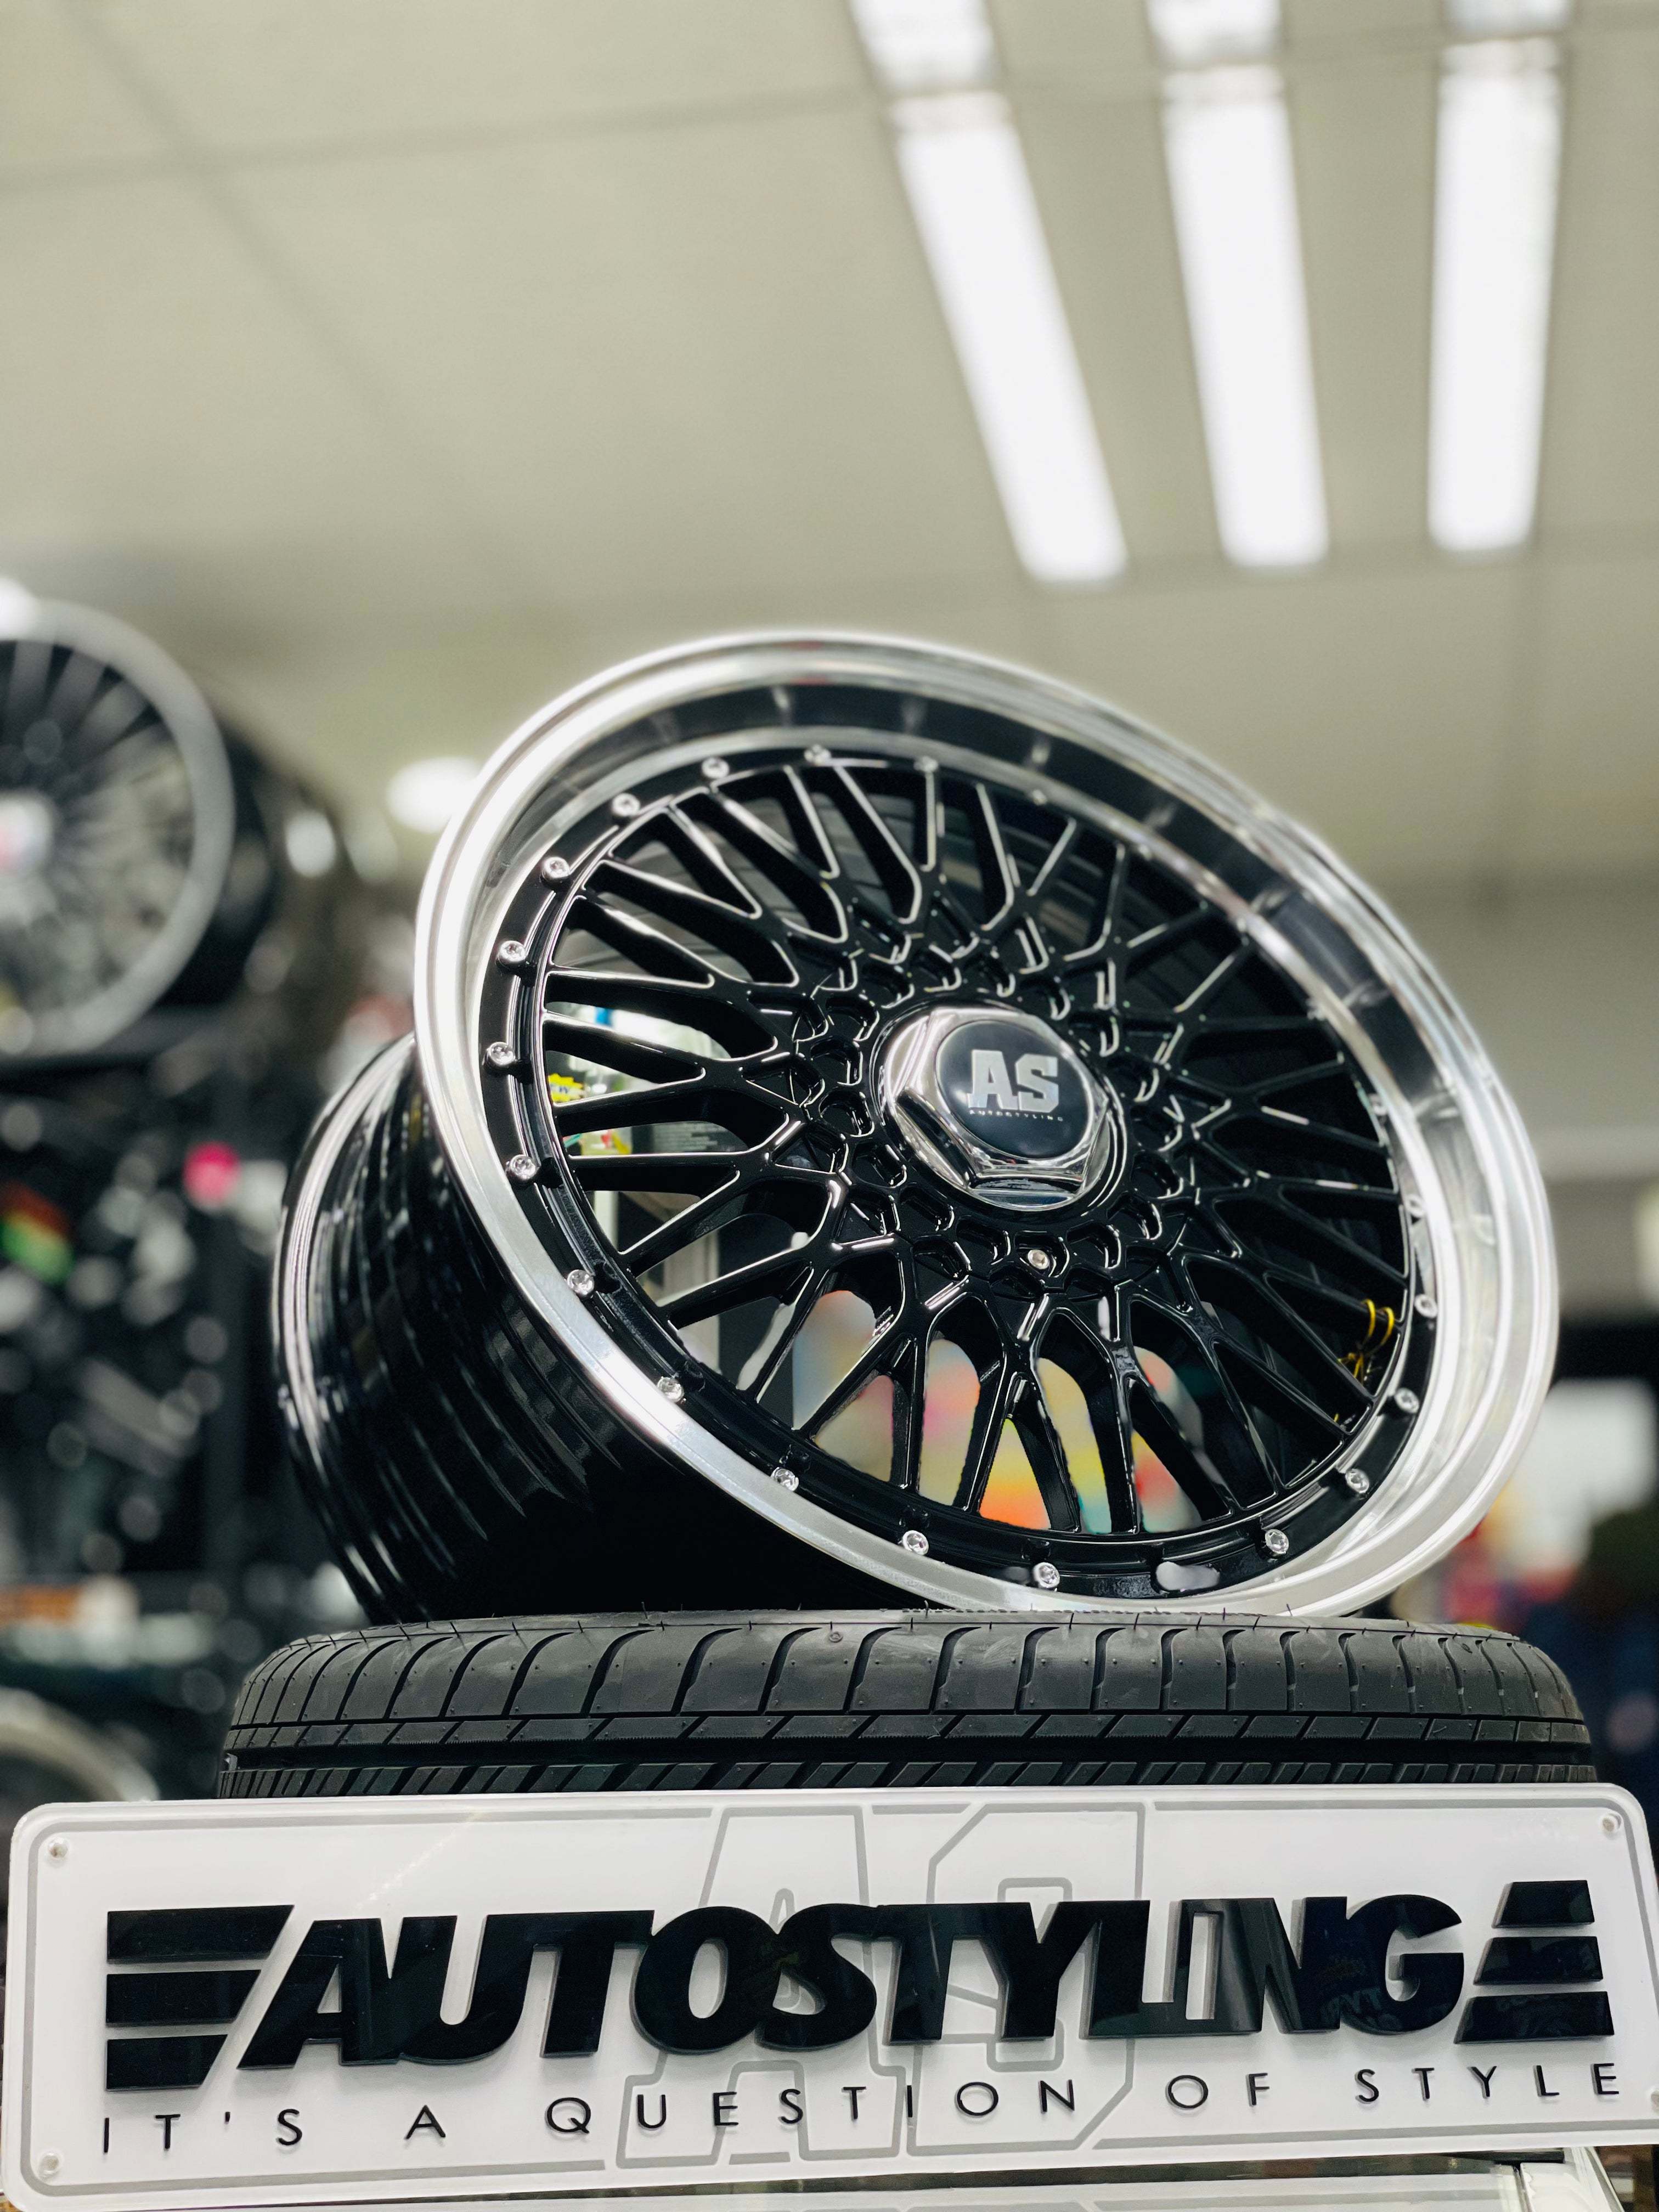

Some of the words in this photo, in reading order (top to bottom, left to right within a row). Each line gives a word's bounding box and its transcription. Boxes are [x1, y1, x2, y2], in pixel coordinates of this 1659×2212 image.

[967, 1049, 1059, 1113] AS
[236, 1894, 1465, 2070] AUTOSTYLING
[103, 2108, 303, 2153] IT'S
[405, 2105, 447, 2141] A
[546, 2079, 1075, 2135] QUESTION
[1165, 2073, 1270, 2110] OF
[1355, 2062, 1620, 2103] STYLE
